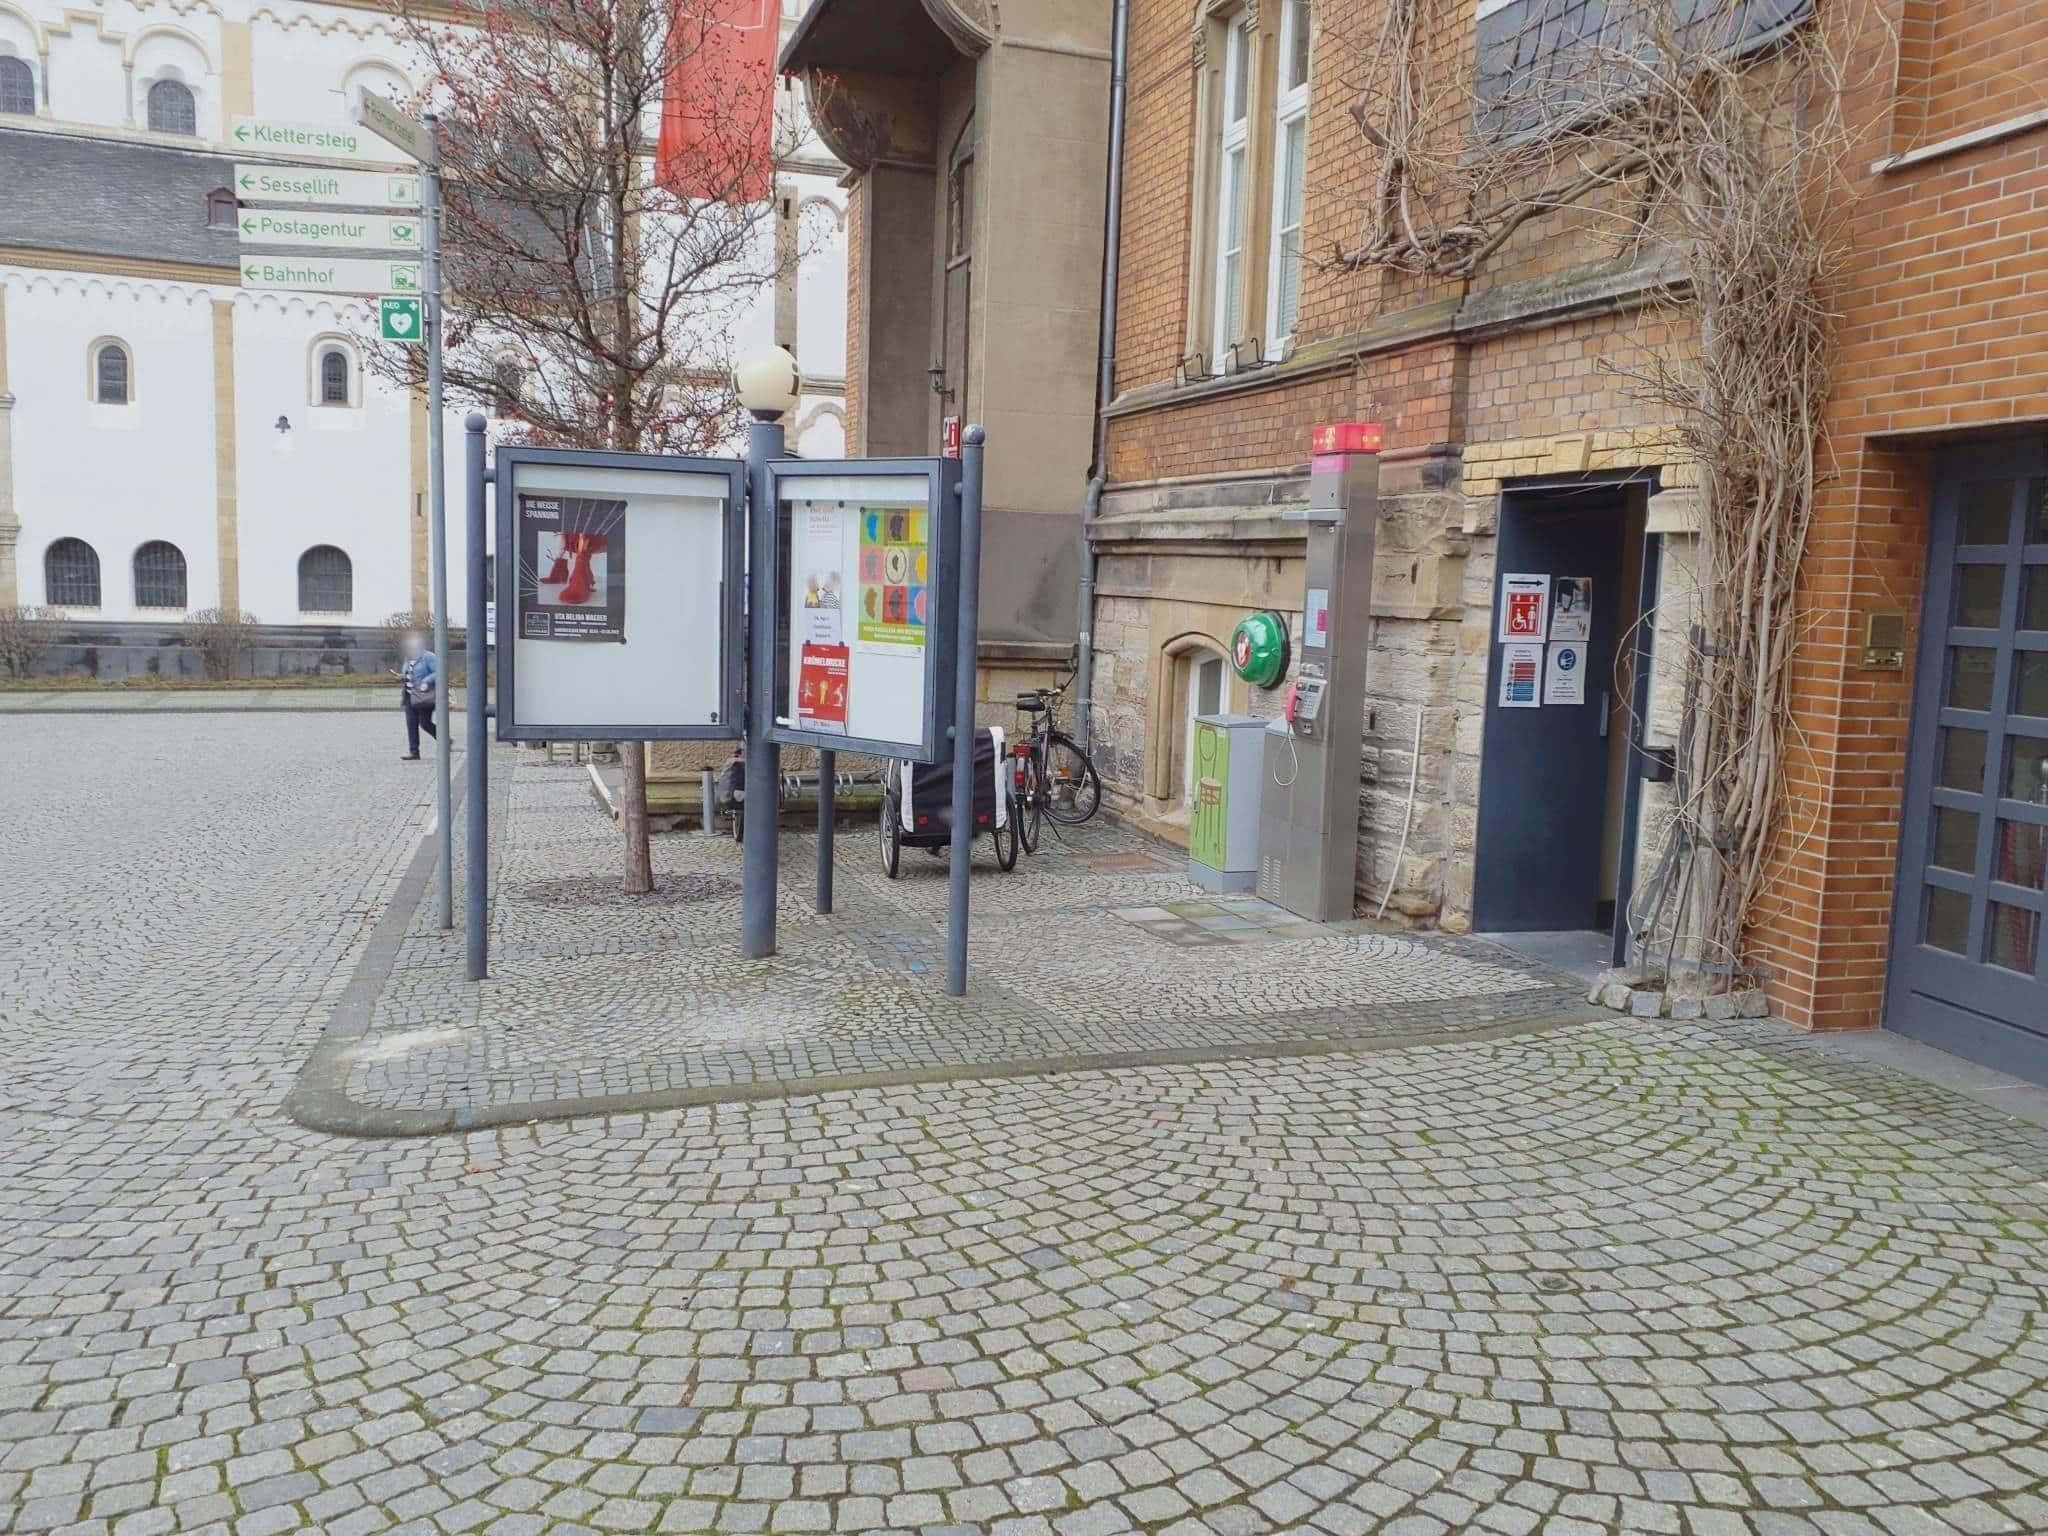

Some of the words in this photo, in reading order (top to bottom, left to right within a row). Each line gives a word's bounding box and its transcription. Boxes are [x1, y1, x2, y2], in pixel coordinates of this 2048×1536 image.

[254, 124, 357, 152] Klettersteig
[260, 176, 339, 195] Sessellift
[260, 217, 366, 238] Postagentur
[263, 266, 335, 283] Bahnhof
[383, 301, 400, 310] AED
